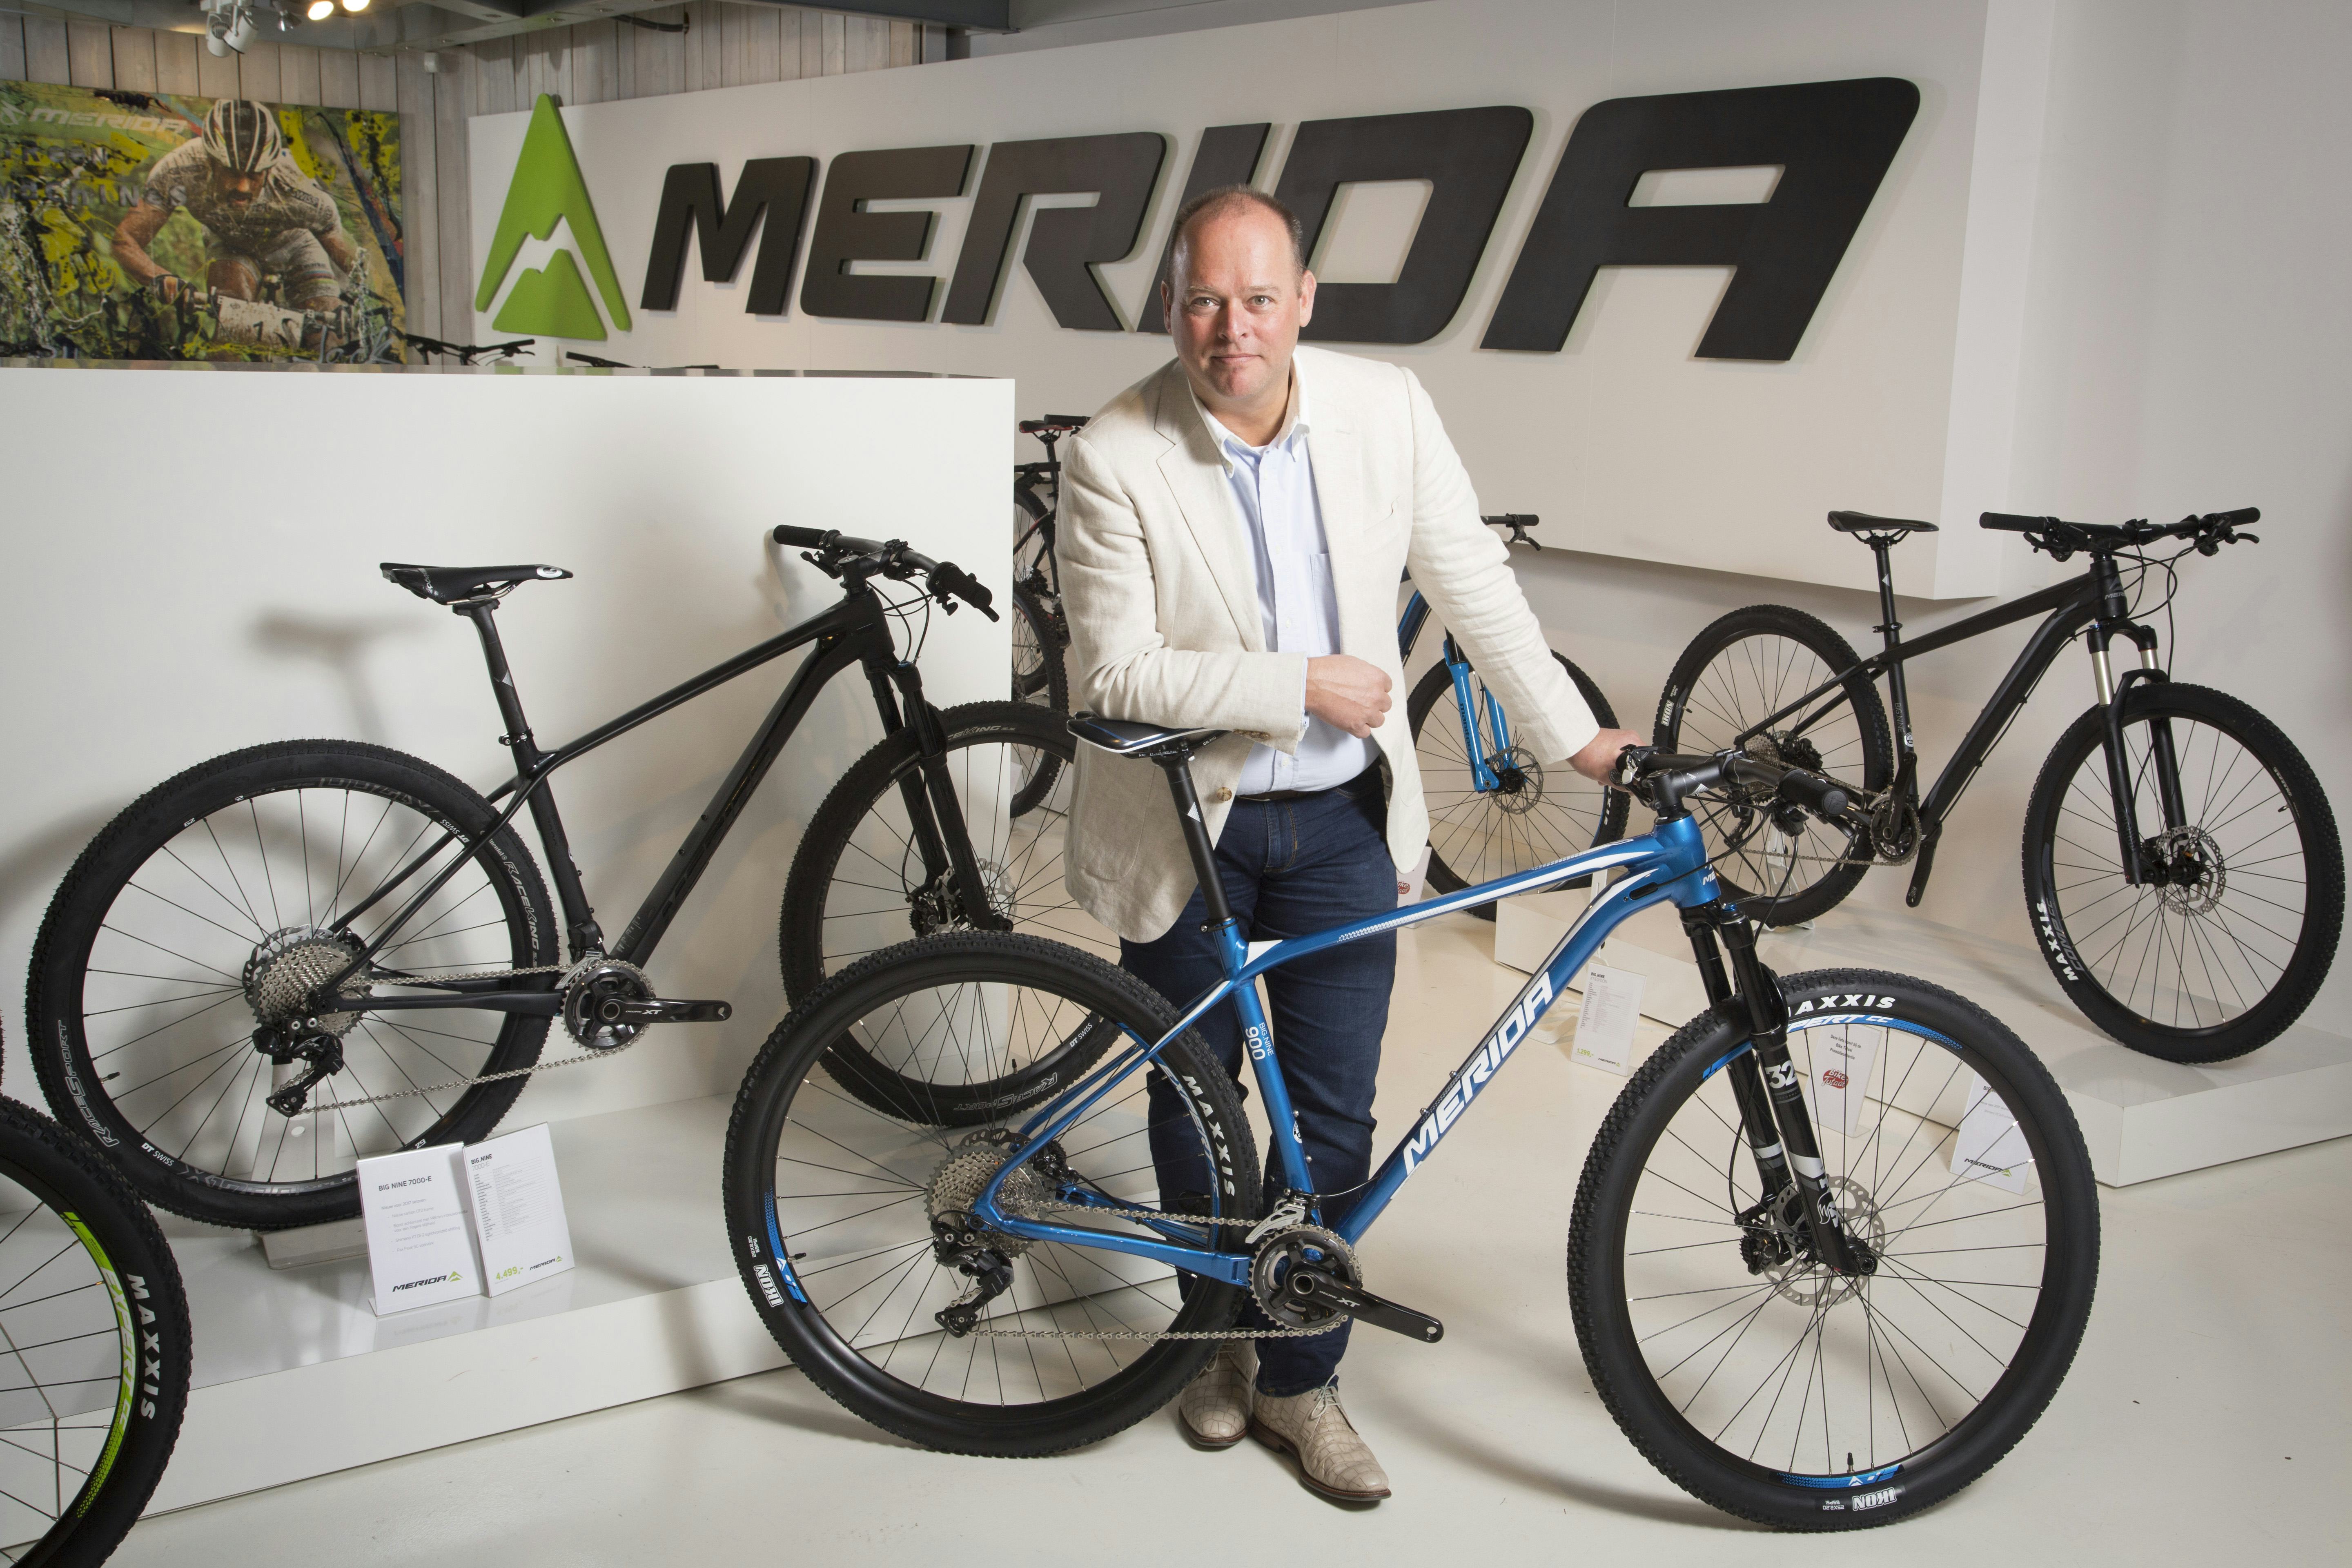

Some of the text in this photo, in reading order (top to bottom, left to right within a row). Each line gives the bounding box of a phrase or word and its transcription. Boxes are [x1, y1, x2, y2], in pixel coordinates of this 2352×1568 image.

[29, 107, 189, 134] MERIDA
[1661, 699, 1675, 726] IKON
[872, 786, 887, 803] SWISS
[440, 819, 470, 843] DT SWISS
[2037, 902, 2079, 981] MAXXIS
[1788, 994, 1896, 1017] AXXIS
[1069, 1022, 1093, 1048] DT SWISS
[1245, 1026, 1265, 1060] 900
[1259, 1022, 1274, 1057] BIG.NINE
[1403, 971, 1553, 1176] MERIDA
[1765, 1060, 1797, 1088] 32
[1829, 1069, 1846, 1080] Bike
[1182, 1075, 1235, 1197] MAXXIS
[141, 1142, 154, 1153] DT
[153, 1150, 175, 1167] SWISS
[471, 1154, 492, 1165] BIG.NINE
[472, 1161, 490, 1171] 7000-E
[1964, 1158, 2003, 1172] MERIDA
[391, 1180, 408, 1189] NINE
[408, 1176, 432, 1186] 7000-E
[425, 1228, 448, 1236] synchronized
[495, 1265, 523, 1281] 4.499,-
[530, 1258, 556, 1271] MERIDA
[392, 1275, 448, 1292] MERIDA
[753, 1264, 784, 1307] IKON
[1319, 1290, 1361, 1307] DEORE XT
[100, 1266, 136, 1431] EXPERT CC
[127, 1273, 160, 1420] MAXXIS
[1852, 1487, 1898, 1511] IKON
